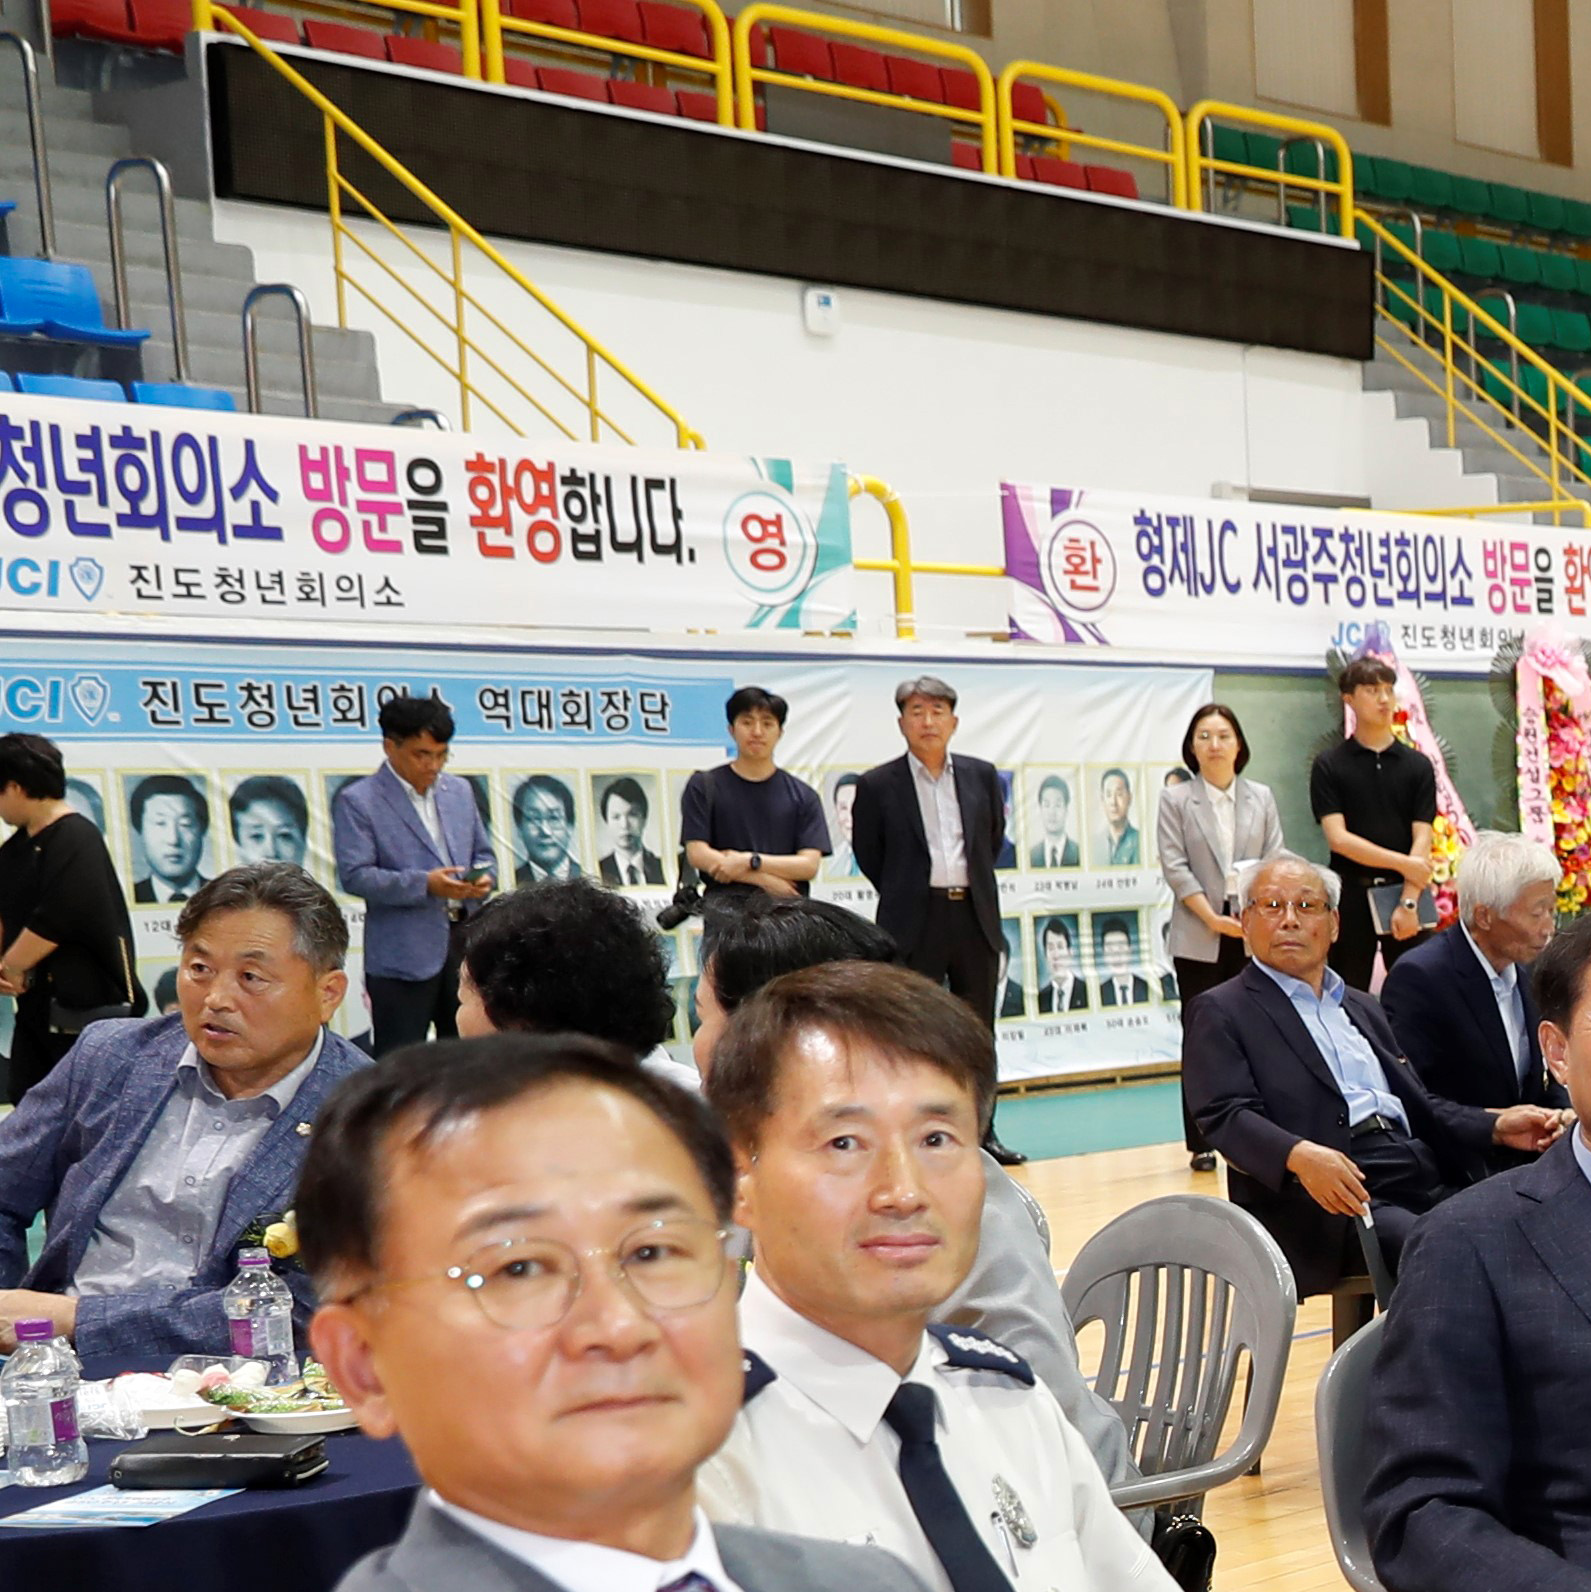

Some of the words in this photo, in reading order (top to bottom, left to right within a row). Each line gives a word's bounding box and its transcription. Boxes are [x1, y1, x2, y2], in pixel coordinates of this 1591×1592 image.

[0, 414, 284, 546] 청년회의소
[298, 443, 450, 556] 방문을
[463, 451, 697, 566] 환영합니다.
[740, 512, 787, 573] 영
[1062, 537, 1103, 593] 환
[1132, 508, 1242, 598] 형제JC
[1252, 520, 1475, 612] 서광주청년회의소
[1481, 538, 1554, 616] 방문을
[0, 557, 60, 598] CI
[129, 563, 405, 609] 진도청년회의소
[0, 678, 63, 721] CI
[479, 684, 671, 735] 역대회장단
